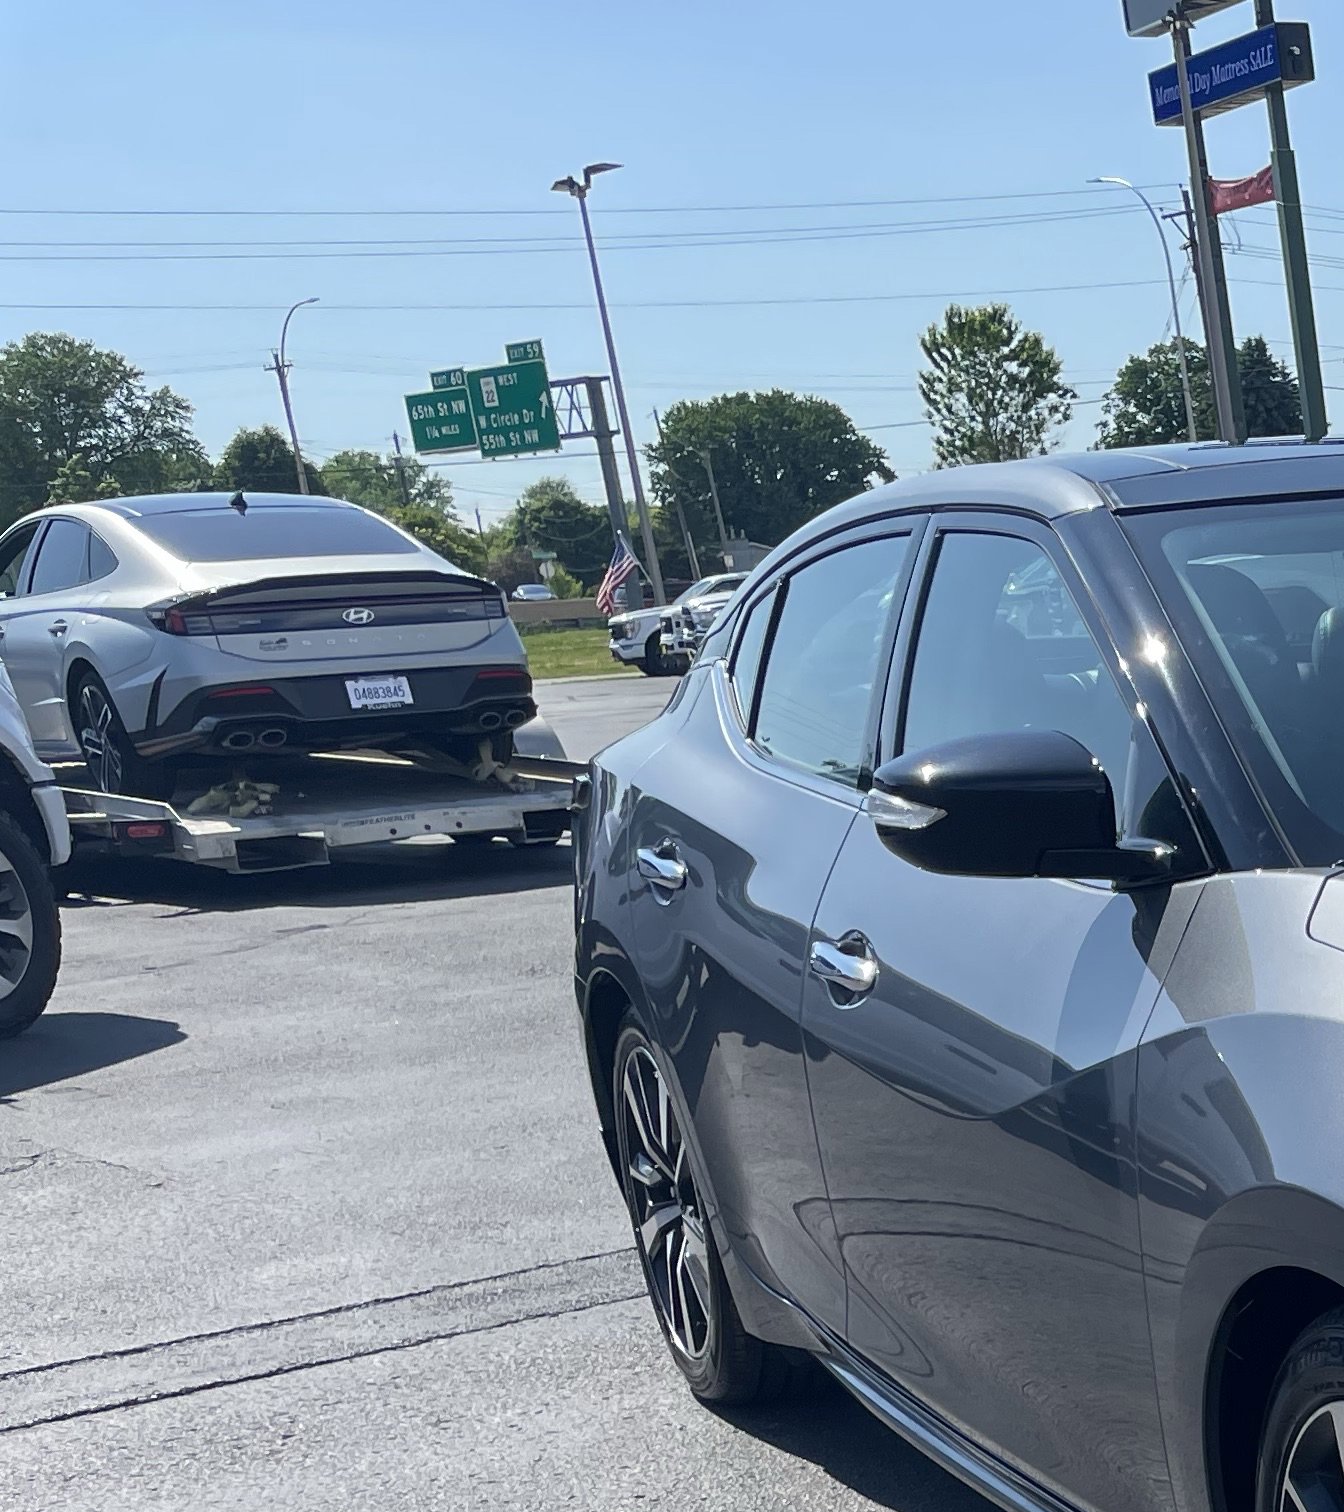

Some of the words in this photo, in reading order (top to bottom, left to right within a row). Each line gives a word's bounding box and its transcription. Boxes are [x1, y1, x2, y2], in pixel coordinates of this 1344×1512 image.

[1155, 74, 1194, 107] Memol
[1195, 73, 1210, 95] Day
[1211, 59, 1249, 87] Mattress
[1250, 44, 1274, 71] SALE
[510, 347, 524, 359] EXIT
[526, 343, 539, 358] 59
[450, 371, 462, 385] 60
[498, 373, 518, 386] WEST
[485, 389, 495, 404] 22
[412, 404, 435, 420] 65th
[437, 402, 448, 416] St
[451, 400, 466, 414] NW
[478, 415, 487, 429] W
[490, 412, 519, 428] Circle
[522, 409, 534, 423] Dr
[441, 424, 460, 435] MILES
[482, 434, 506, 449] 55th
[509, 431, 521, 446] St
[524, 429, 539, 444] NW
[302, 634, 427, 646] SONATA
[353, 685, 406, 701] 04883845
